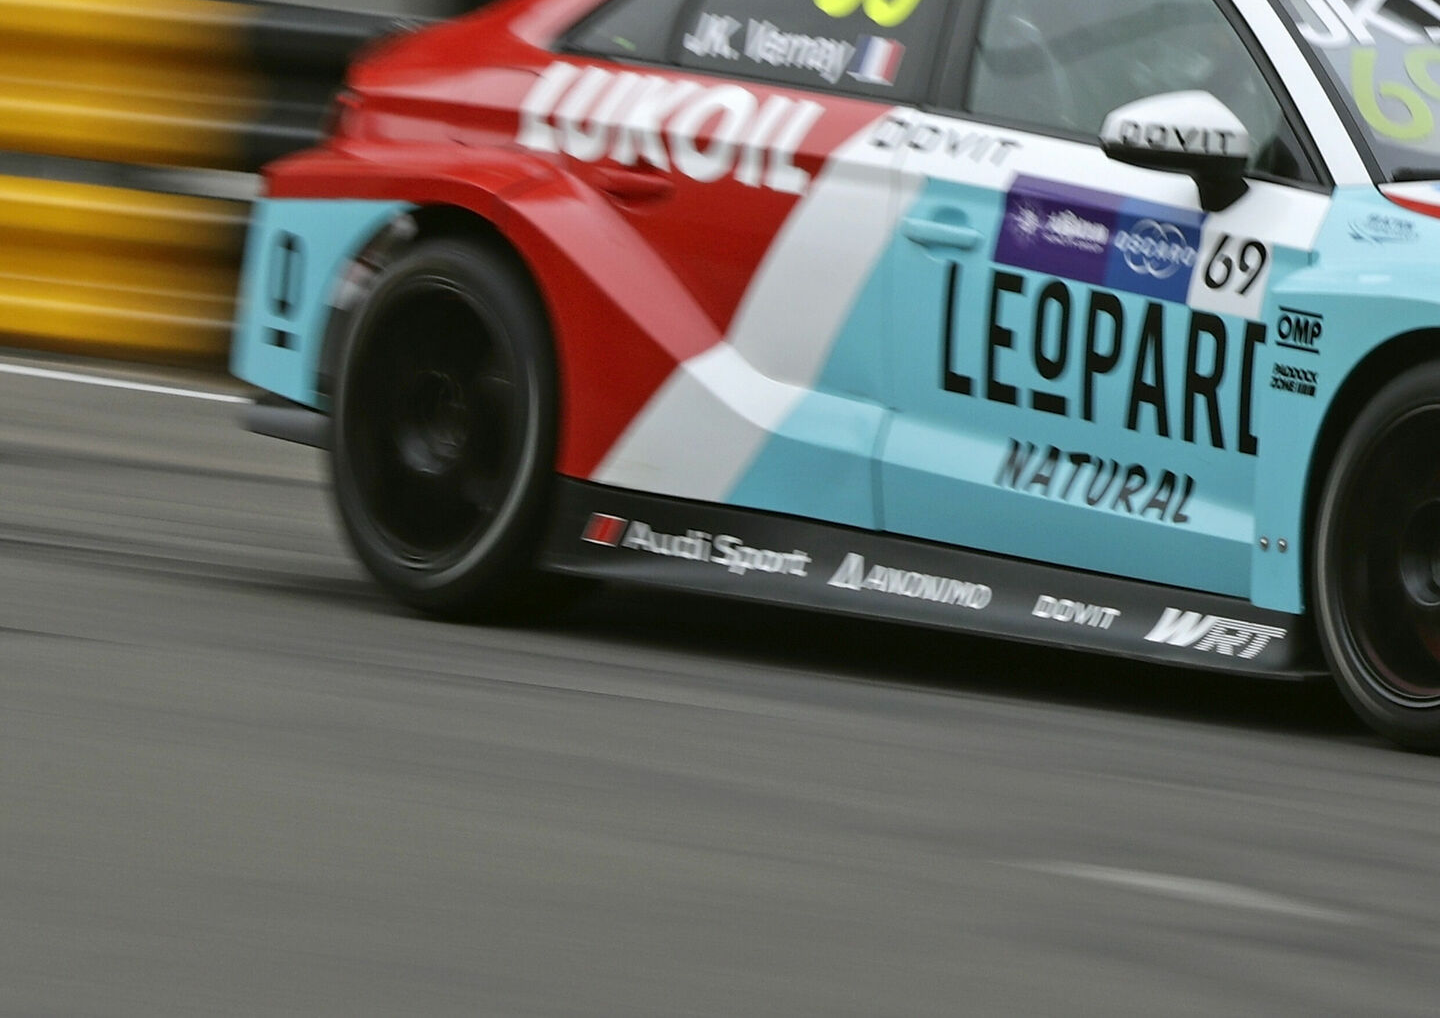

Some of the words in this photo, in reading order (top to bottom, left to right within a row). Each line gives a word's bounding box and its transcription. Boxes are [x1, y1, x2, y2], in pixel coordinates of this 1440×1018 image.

[516, 60, 826, 195] LUKOIL
[1204, 234, 1268, 296] 69
[1277, 313, 1322, 346] OMP
[994, 436, 1197, 525] NATURAL
[622, 520, 712, 562] Audi
[710, 535, 812, 576] Sport
[1144, 607, 1288, 661] WRT
